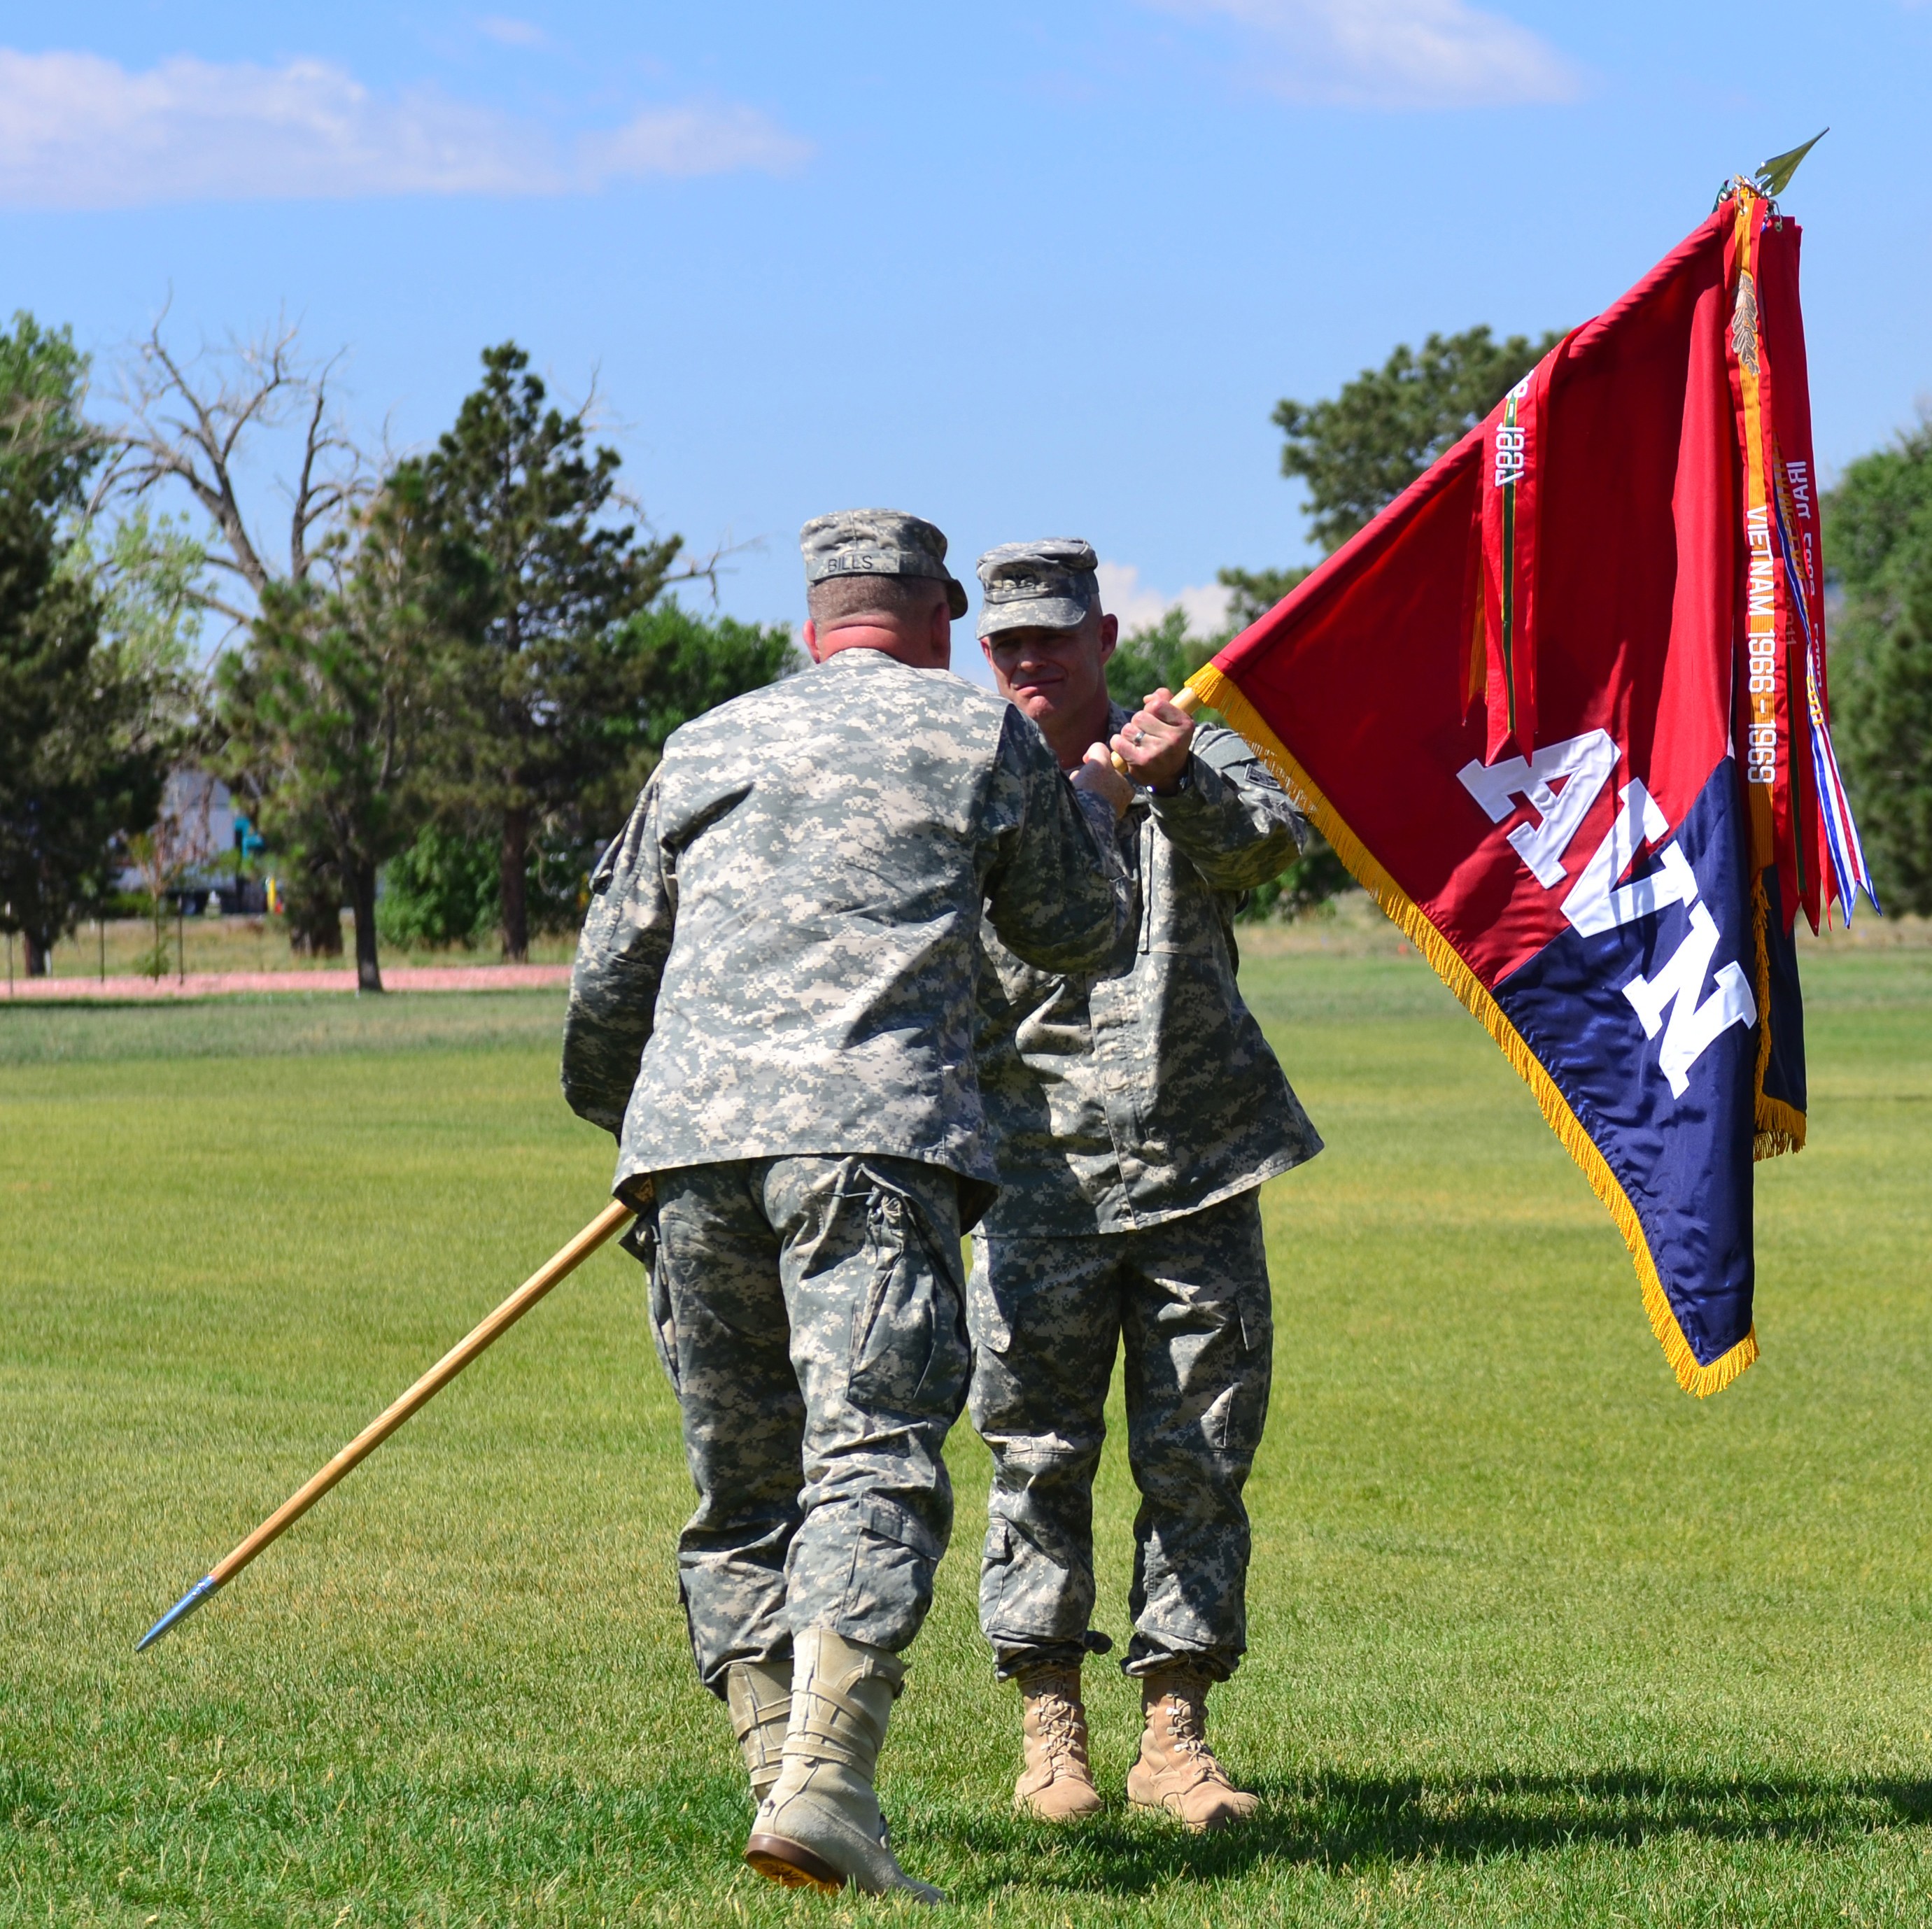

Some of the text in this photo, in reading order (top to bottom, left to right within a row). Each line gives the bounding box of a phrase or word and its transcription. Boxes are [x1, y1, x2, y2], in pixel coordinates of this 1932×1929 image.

[828, 555, 873, 573] BILLS
[1747, 505, 1775, 616] VIETNAM
[1747, 628, 1777, 693] 1966
[1747, 719, 1777, 784] 1969
[1456, 728, 1757, 1100] AVN
